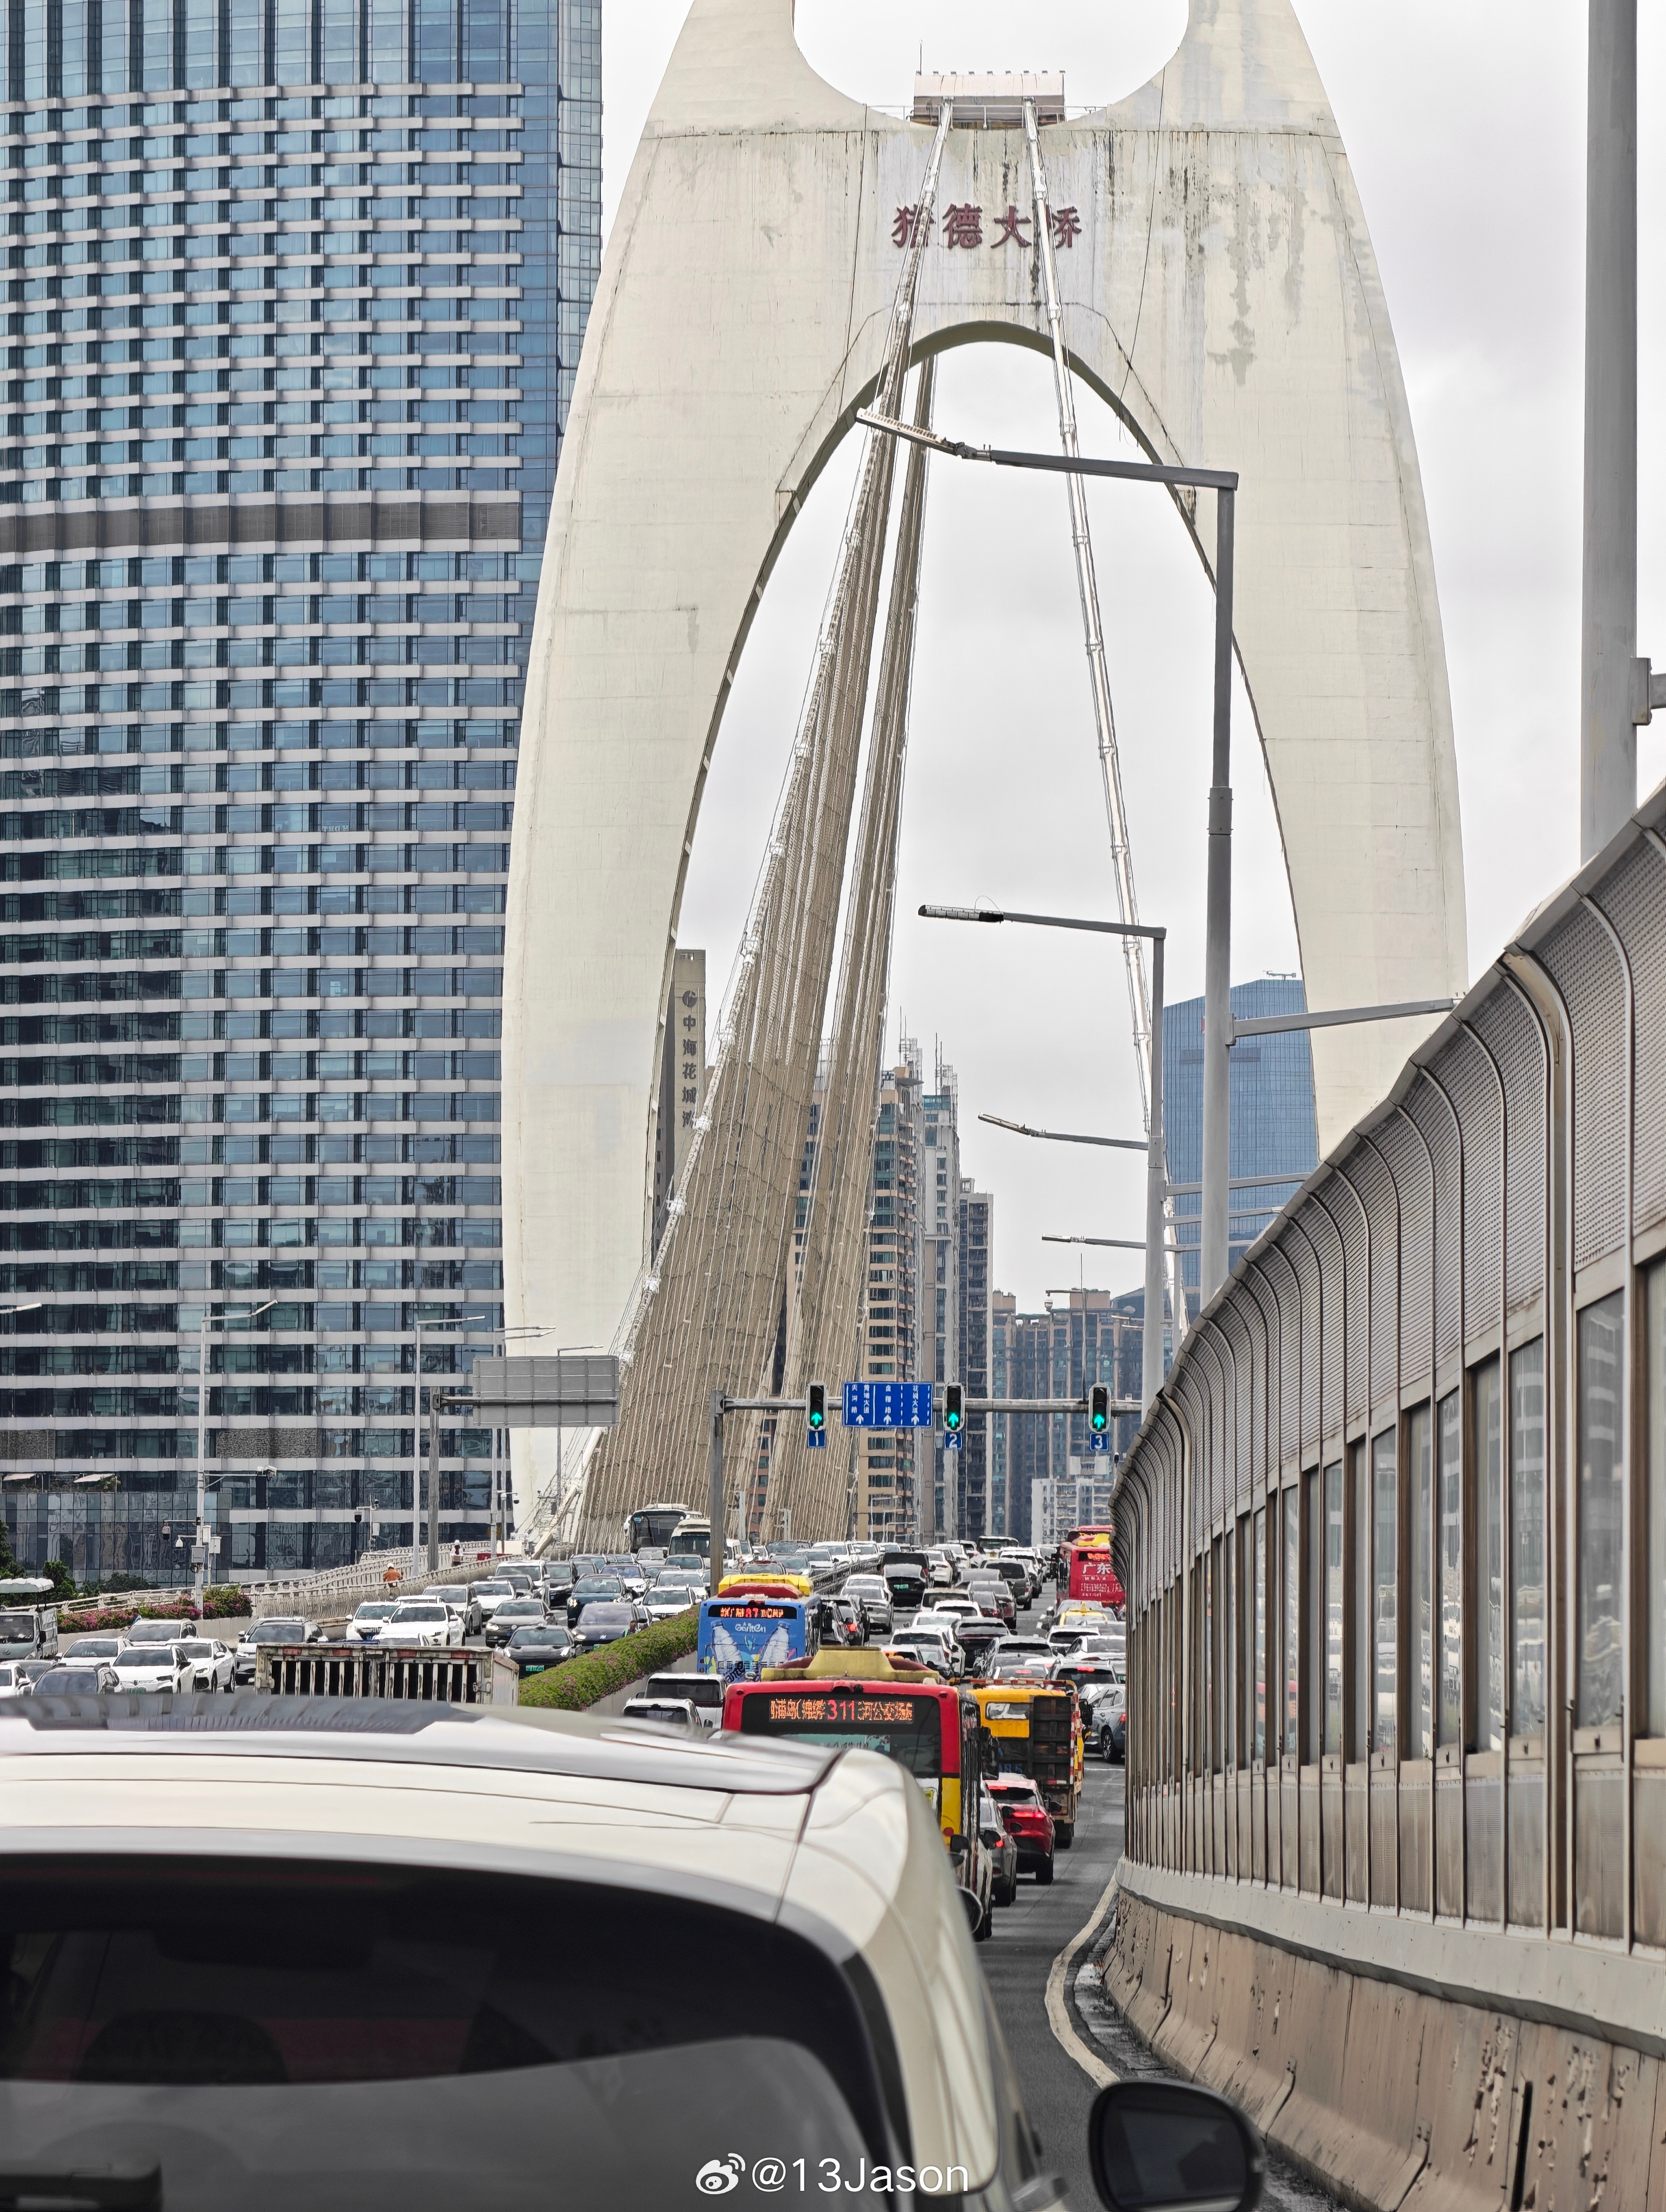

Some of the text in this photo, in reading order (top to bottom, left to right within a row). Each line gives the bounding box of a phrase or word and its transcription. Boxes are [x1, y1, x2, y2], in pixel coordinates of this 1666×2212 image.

[891, 203, 1082, 249] 猎德大桥
[815, 1431, 819, 1445] 1
[949, 1434, 958, 1449] 2
[1094, 1435, 1103, 1450] 3
[827, 1699, 855, 1721] 311
